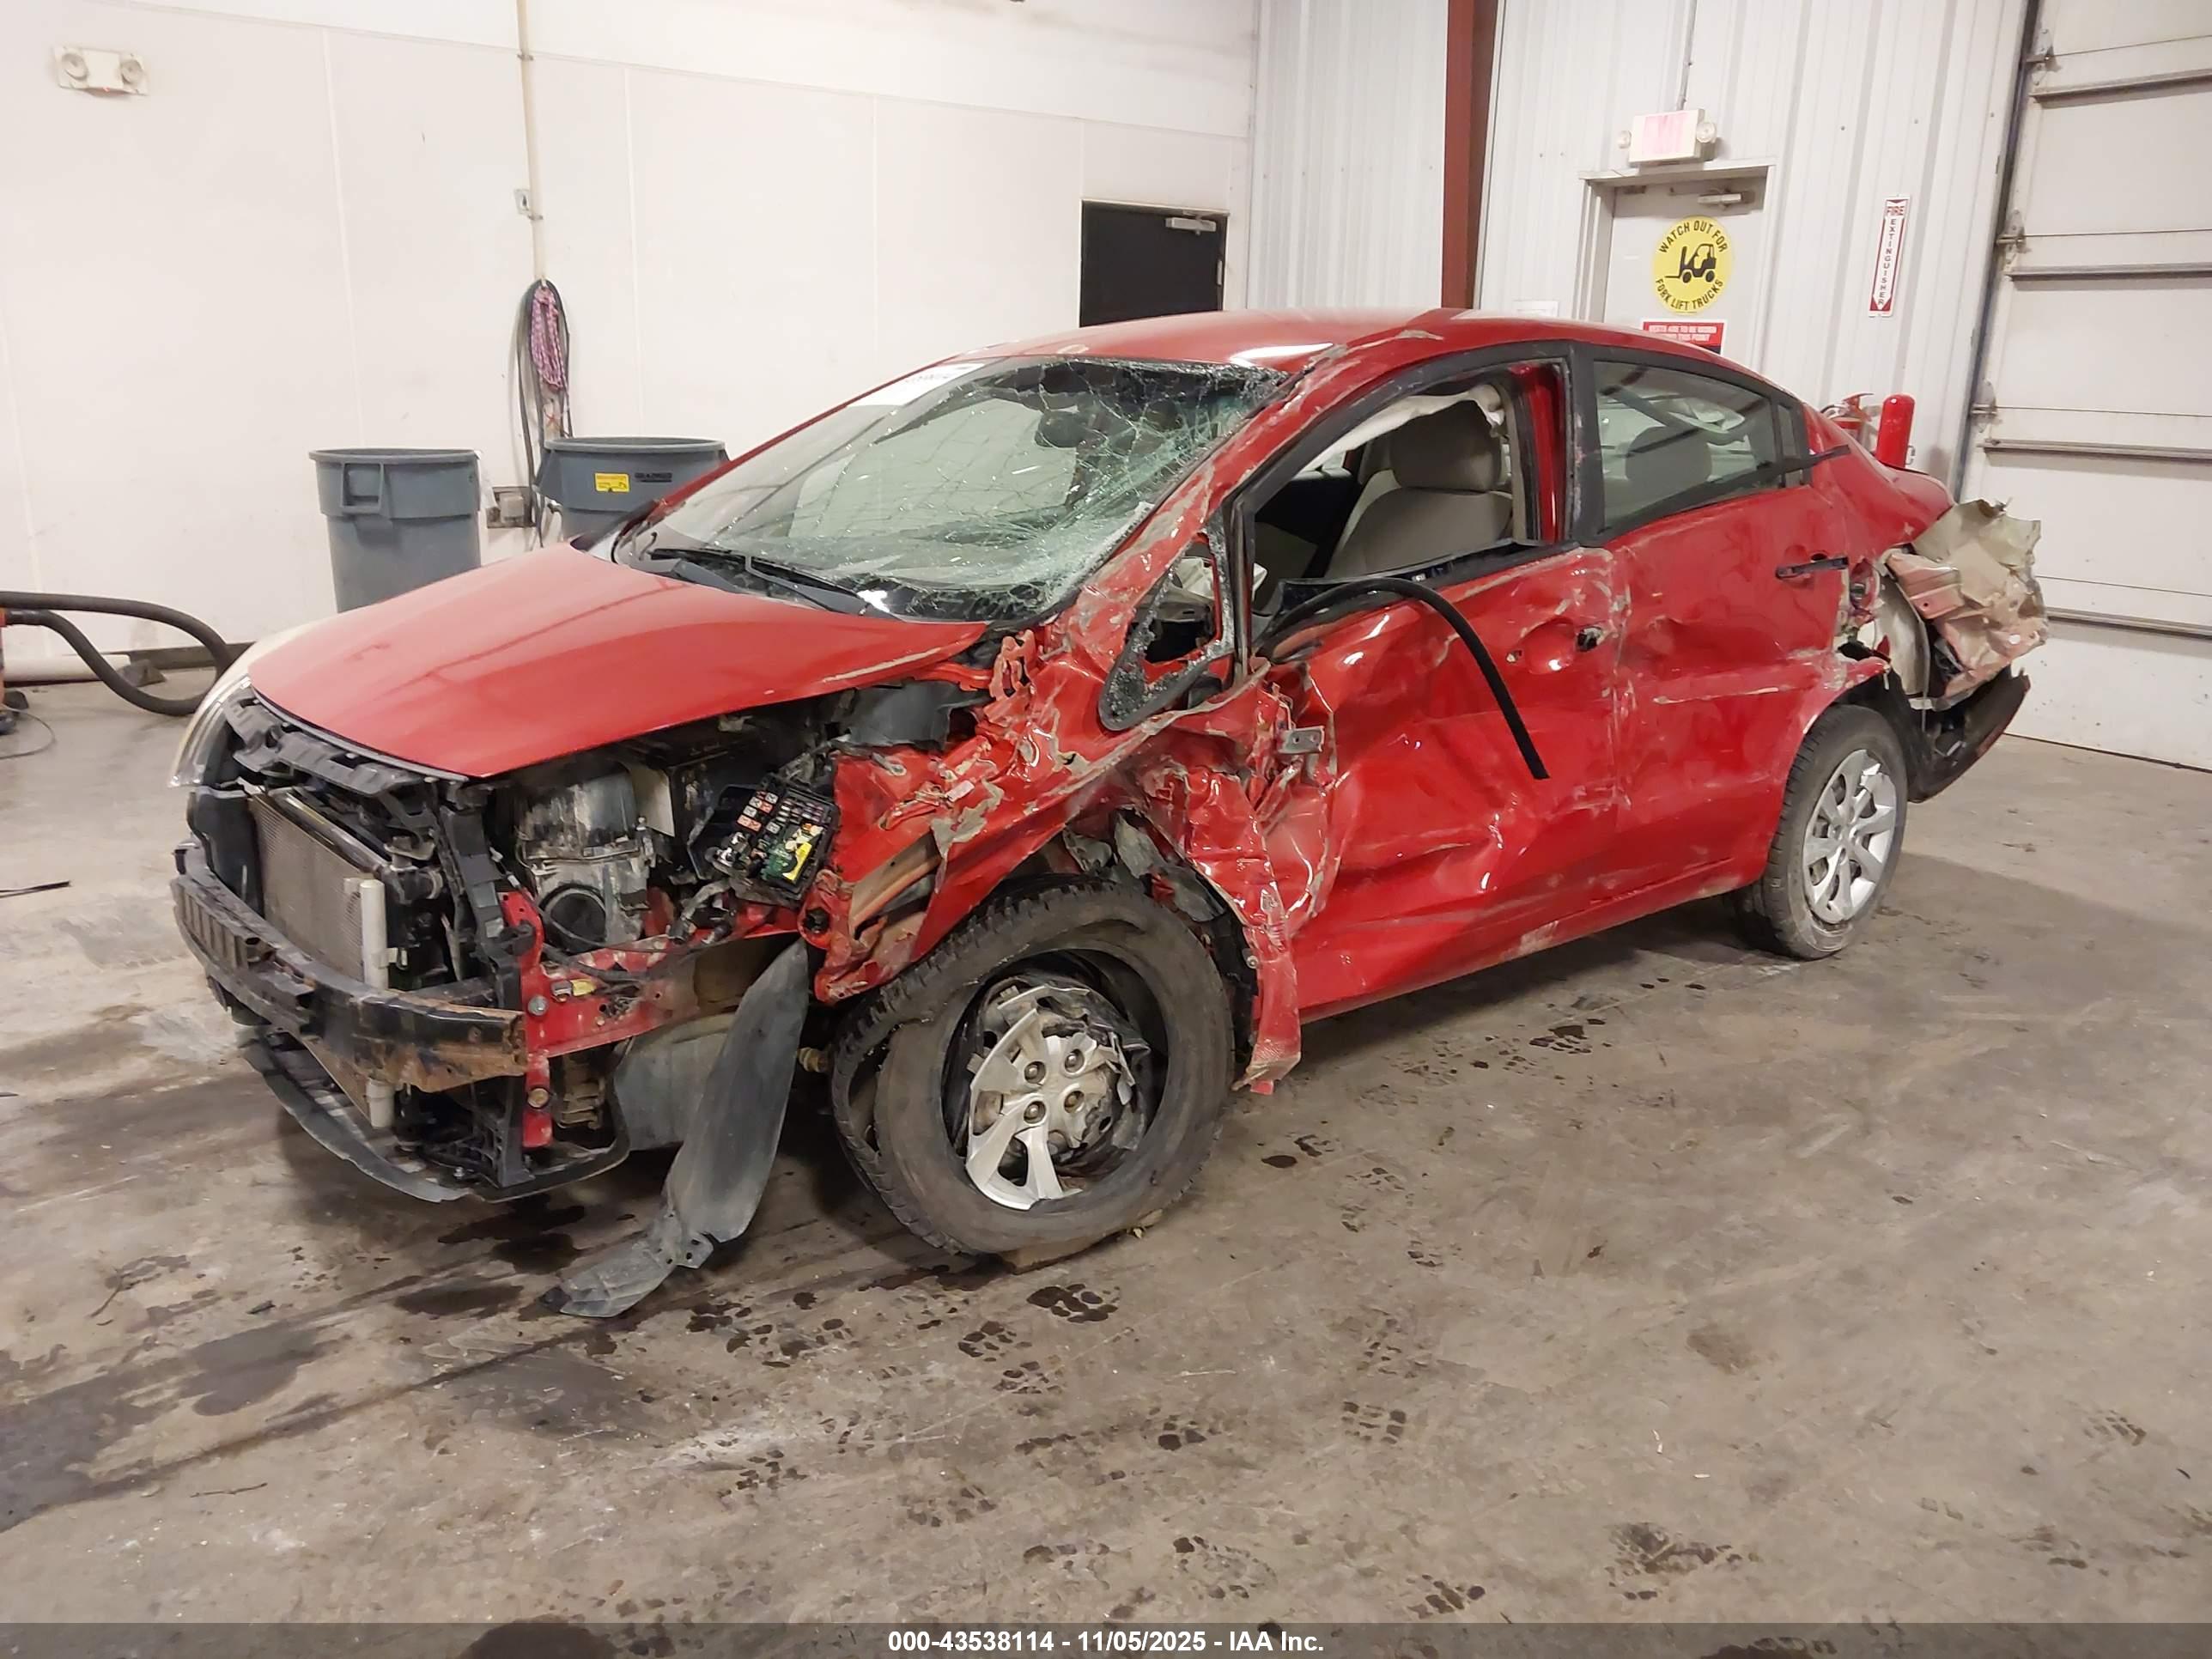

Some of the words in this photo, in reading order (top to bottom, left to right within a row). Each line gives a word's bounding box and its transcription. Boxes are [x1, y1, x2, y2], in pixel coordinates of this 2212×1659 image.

[1659, 222, 1690, 253] WATCH
[1693, 220, 1713, 234] OUT
[1711, 230, 1728, 252] FOR
[1878, 219, 1896, 305] EXTINGUISHER
[1656, 278, 1671, 301] FORK
[1670, 298, 1689, 311] LIFT
[1692, 279, 1723, 310] TRUCKS
